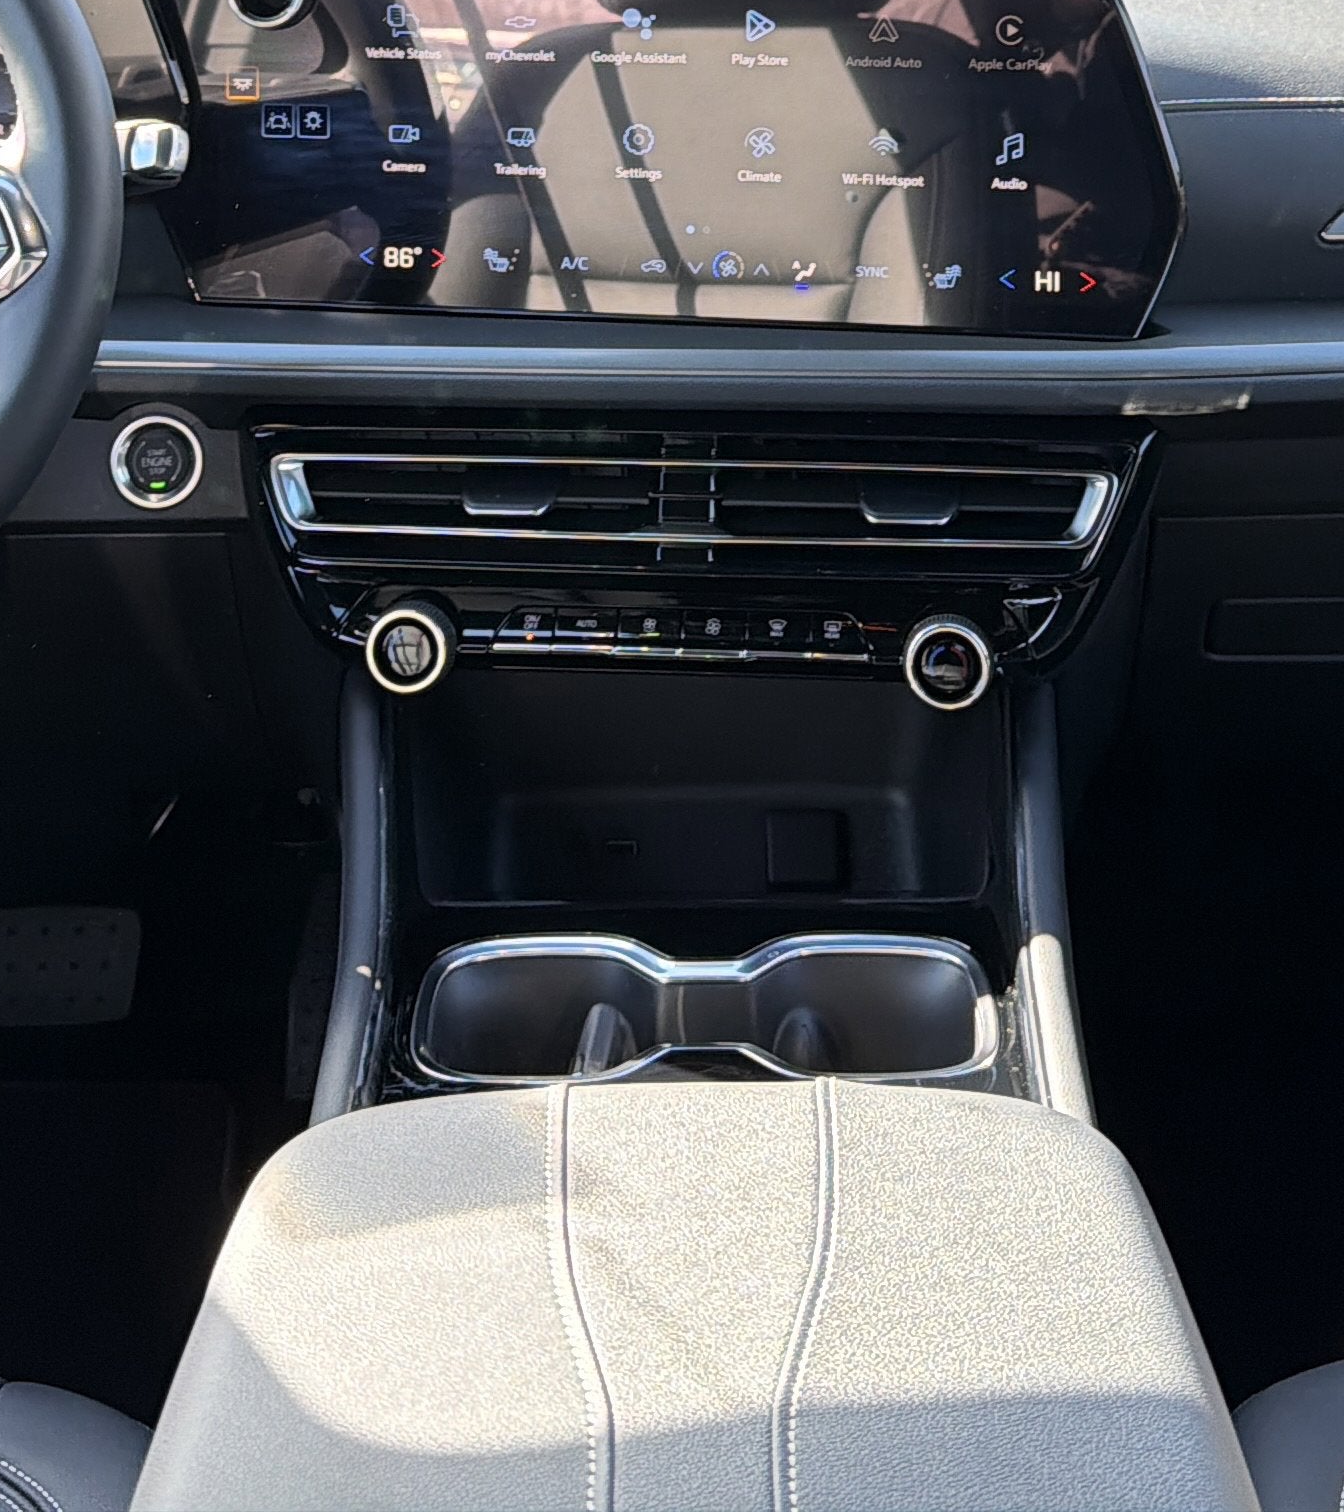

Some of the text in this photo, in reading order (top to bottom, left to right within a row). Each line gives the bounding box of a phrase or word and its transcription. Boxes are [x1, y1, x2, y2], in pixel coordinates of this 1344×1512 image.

[365, 46, 442, 61] Vehicle Status
[485, 49, 556, 64] myChevrolet
[591, 50, 688, 66] Google Assistant
[731, 53, 789, 68] Play Store
[845, 56, 922, 69] Android Auto
[968, 58, 1053, 75] Apple CarPlay
[382, 159, 427, 173] Camera
[494, 162, 547, 179] Trailering
[614, 166, 663, 182] Settings
[737, 169, 782, 183] Climate
[842, 173, 925, 189] Wi-Fi Hotspot
[991, 177, 1029, 190] Audio
[560, 256, 589, 271] A/C
[855, 265, 889, 278] SYNC
[1034, 270, 1061, 292] HI
